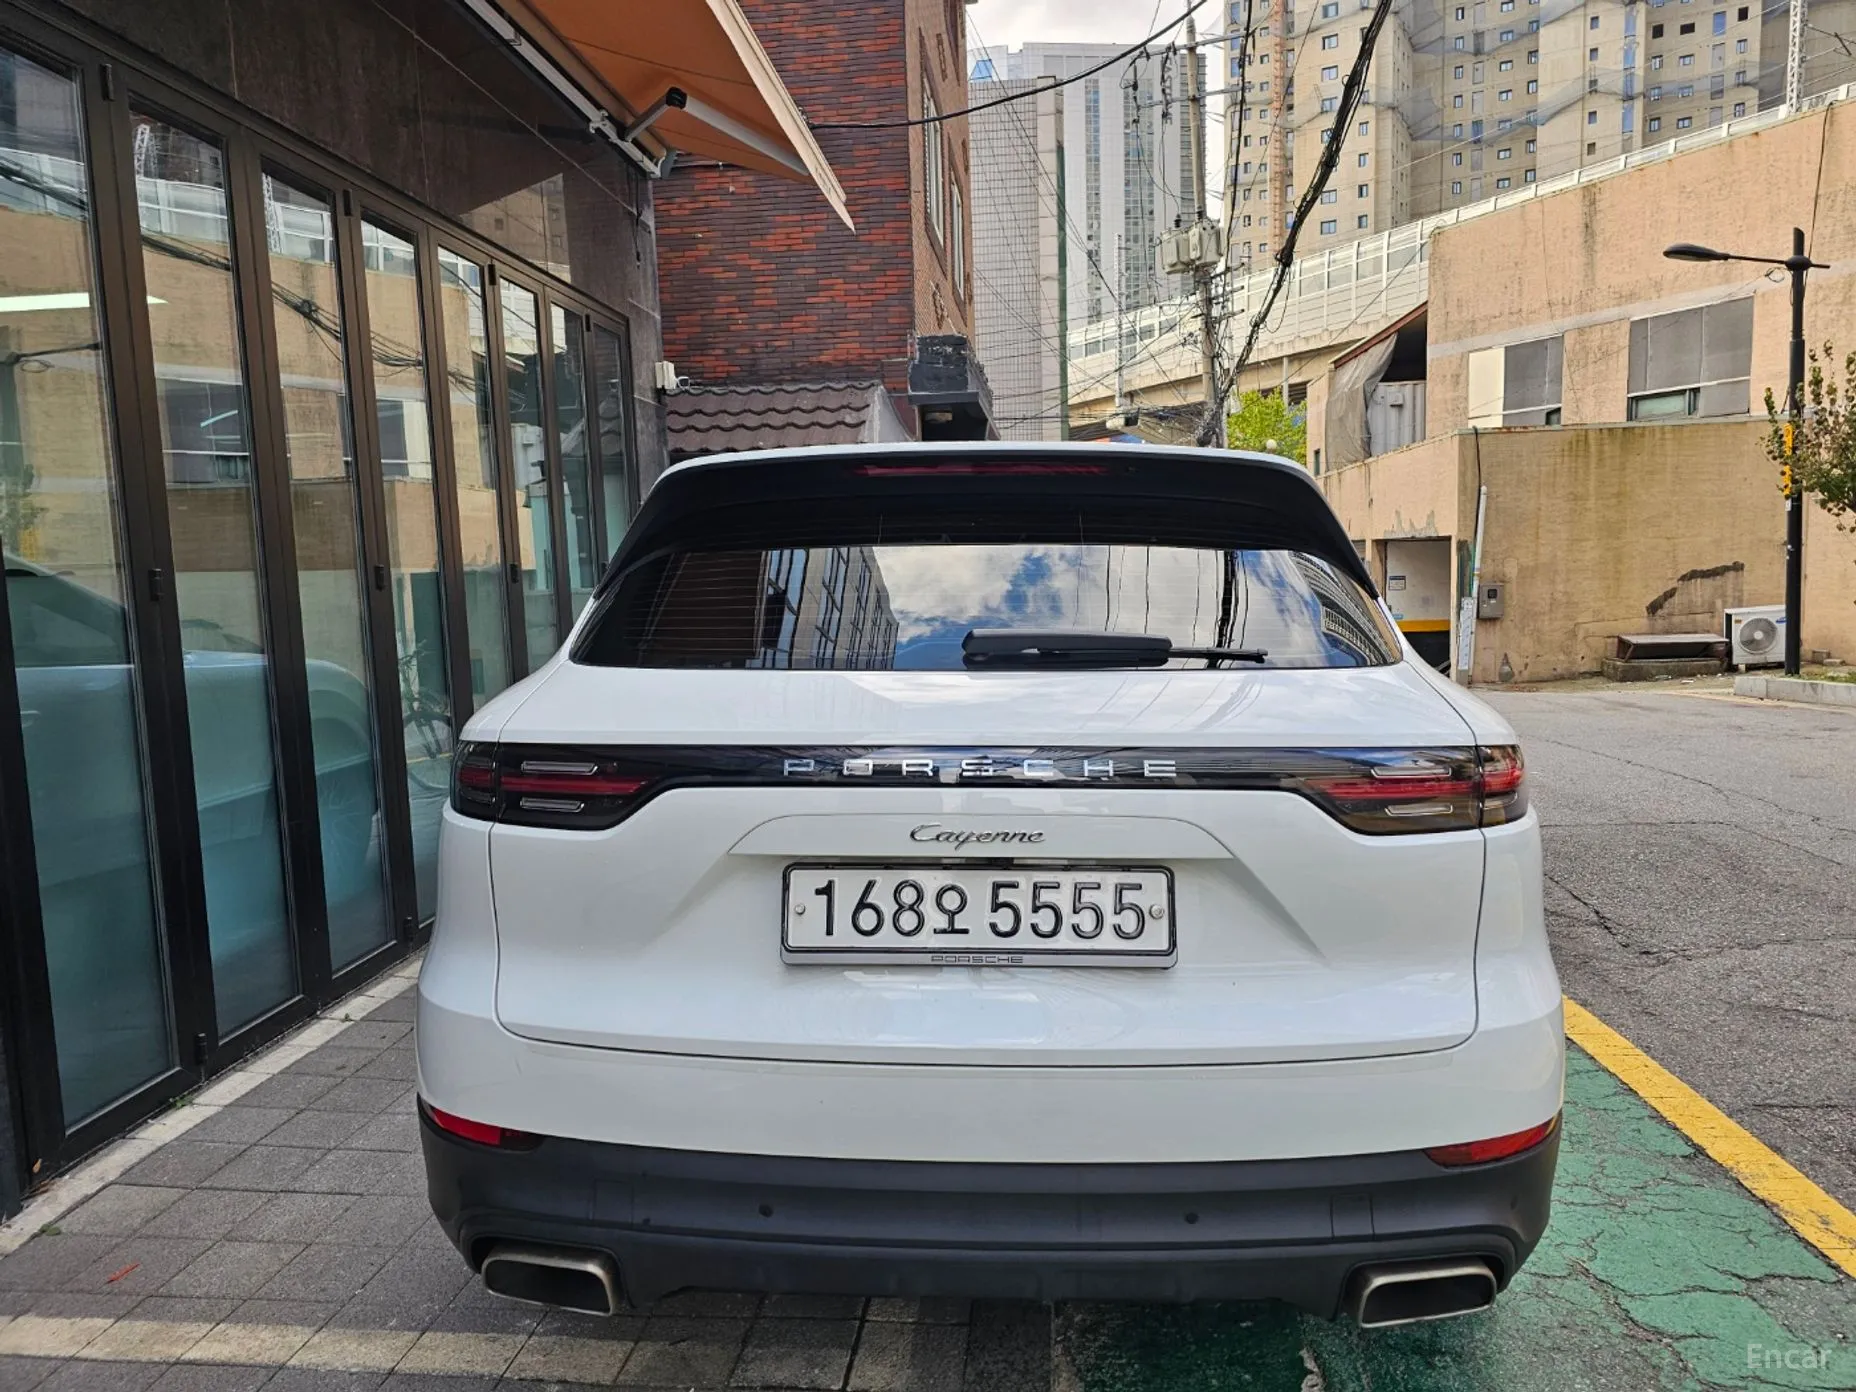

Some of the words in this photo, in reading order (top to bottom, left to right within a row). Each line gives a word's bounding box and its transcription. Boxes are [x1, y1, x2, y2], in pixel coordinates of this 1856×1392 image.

[783, 758, 1177, 777] PORSCHE
[910, 822, 1046, 851] Cayenne
[814, 878, 970, 938] 168오
[988, 880, 1146, 940] 5555
[931, 955, 1024, 964] PORSCHE
